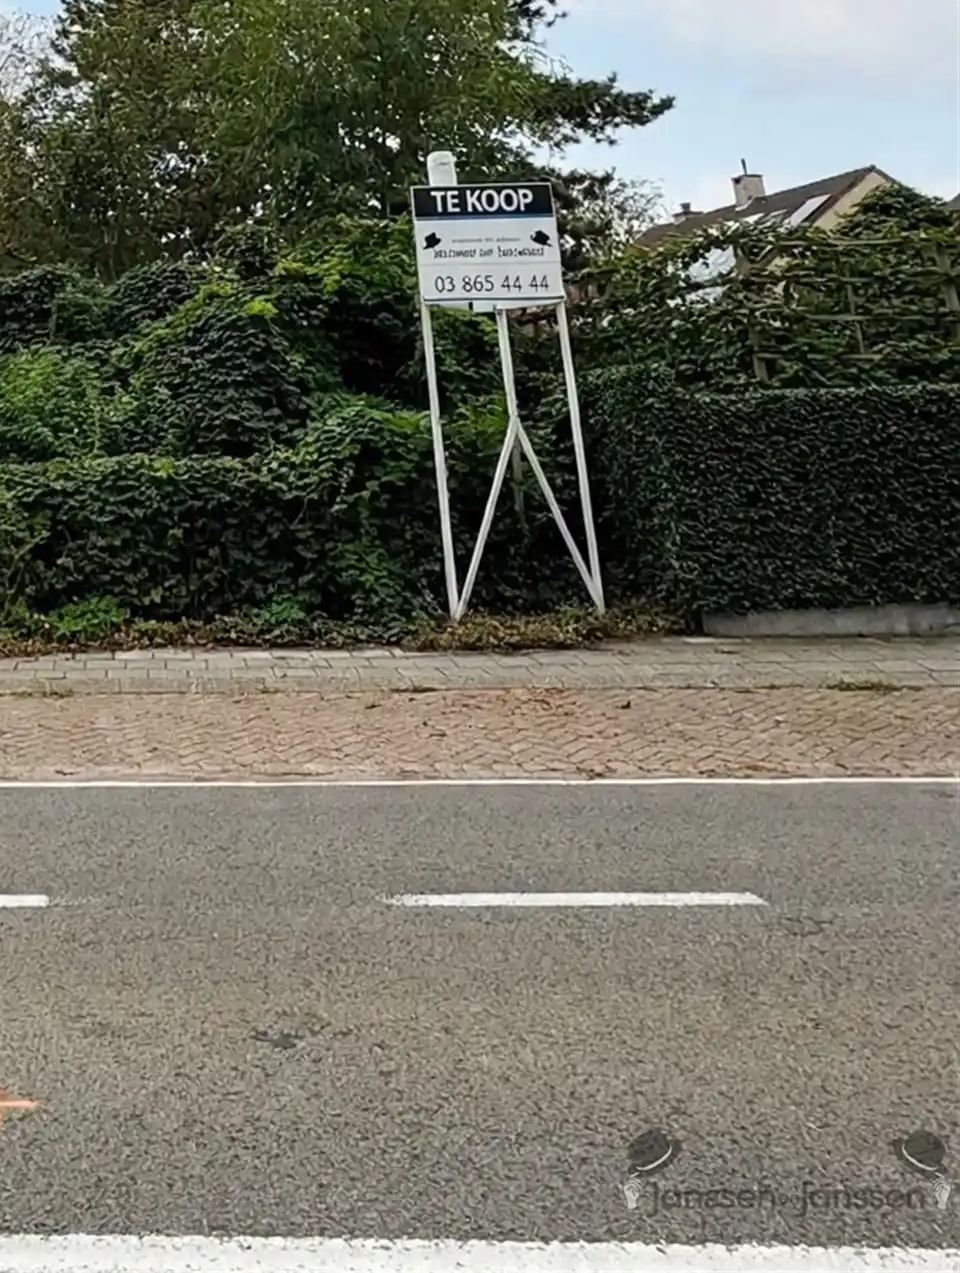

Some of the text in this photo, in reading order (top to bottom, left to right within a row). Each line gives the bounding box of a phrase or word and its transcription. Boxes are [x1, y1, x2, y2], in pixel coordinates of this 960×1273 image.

[430, 188, 533, 212] TE KOOP
[434, 274, 549, 293] 03 865 44 44
